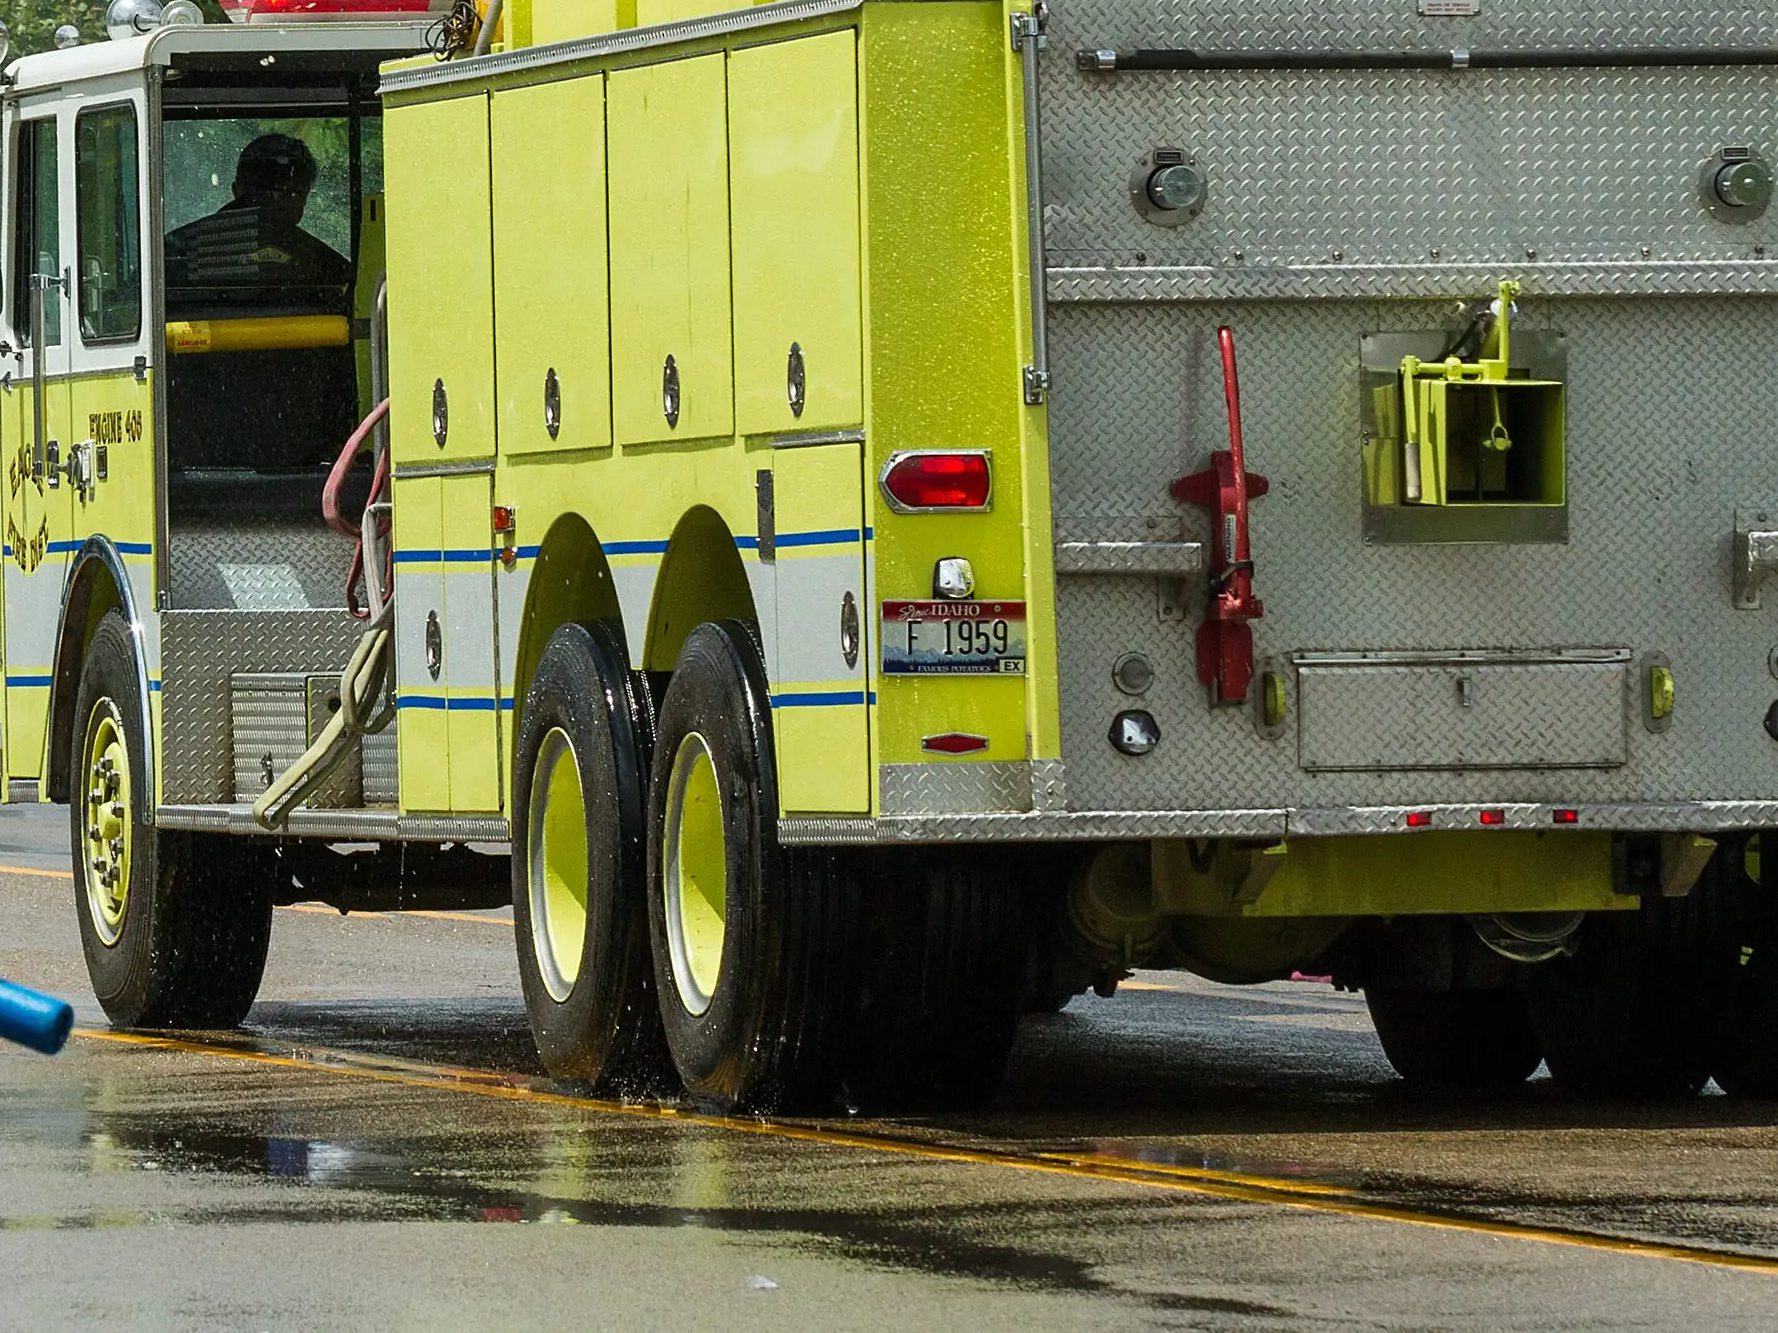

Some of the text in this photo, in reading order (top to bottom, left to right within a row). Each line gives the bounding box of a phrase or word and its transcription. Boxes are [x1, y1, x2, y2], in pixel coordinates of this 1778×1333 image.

[88, 410, 123, 445] ENGINE
[7, 512, 27, 571] FIRE
[931, 604, 981, 617] IDAHO
[907, 618, 1009, 657] F 1959
[1003, 661, 1021, 672] EX
